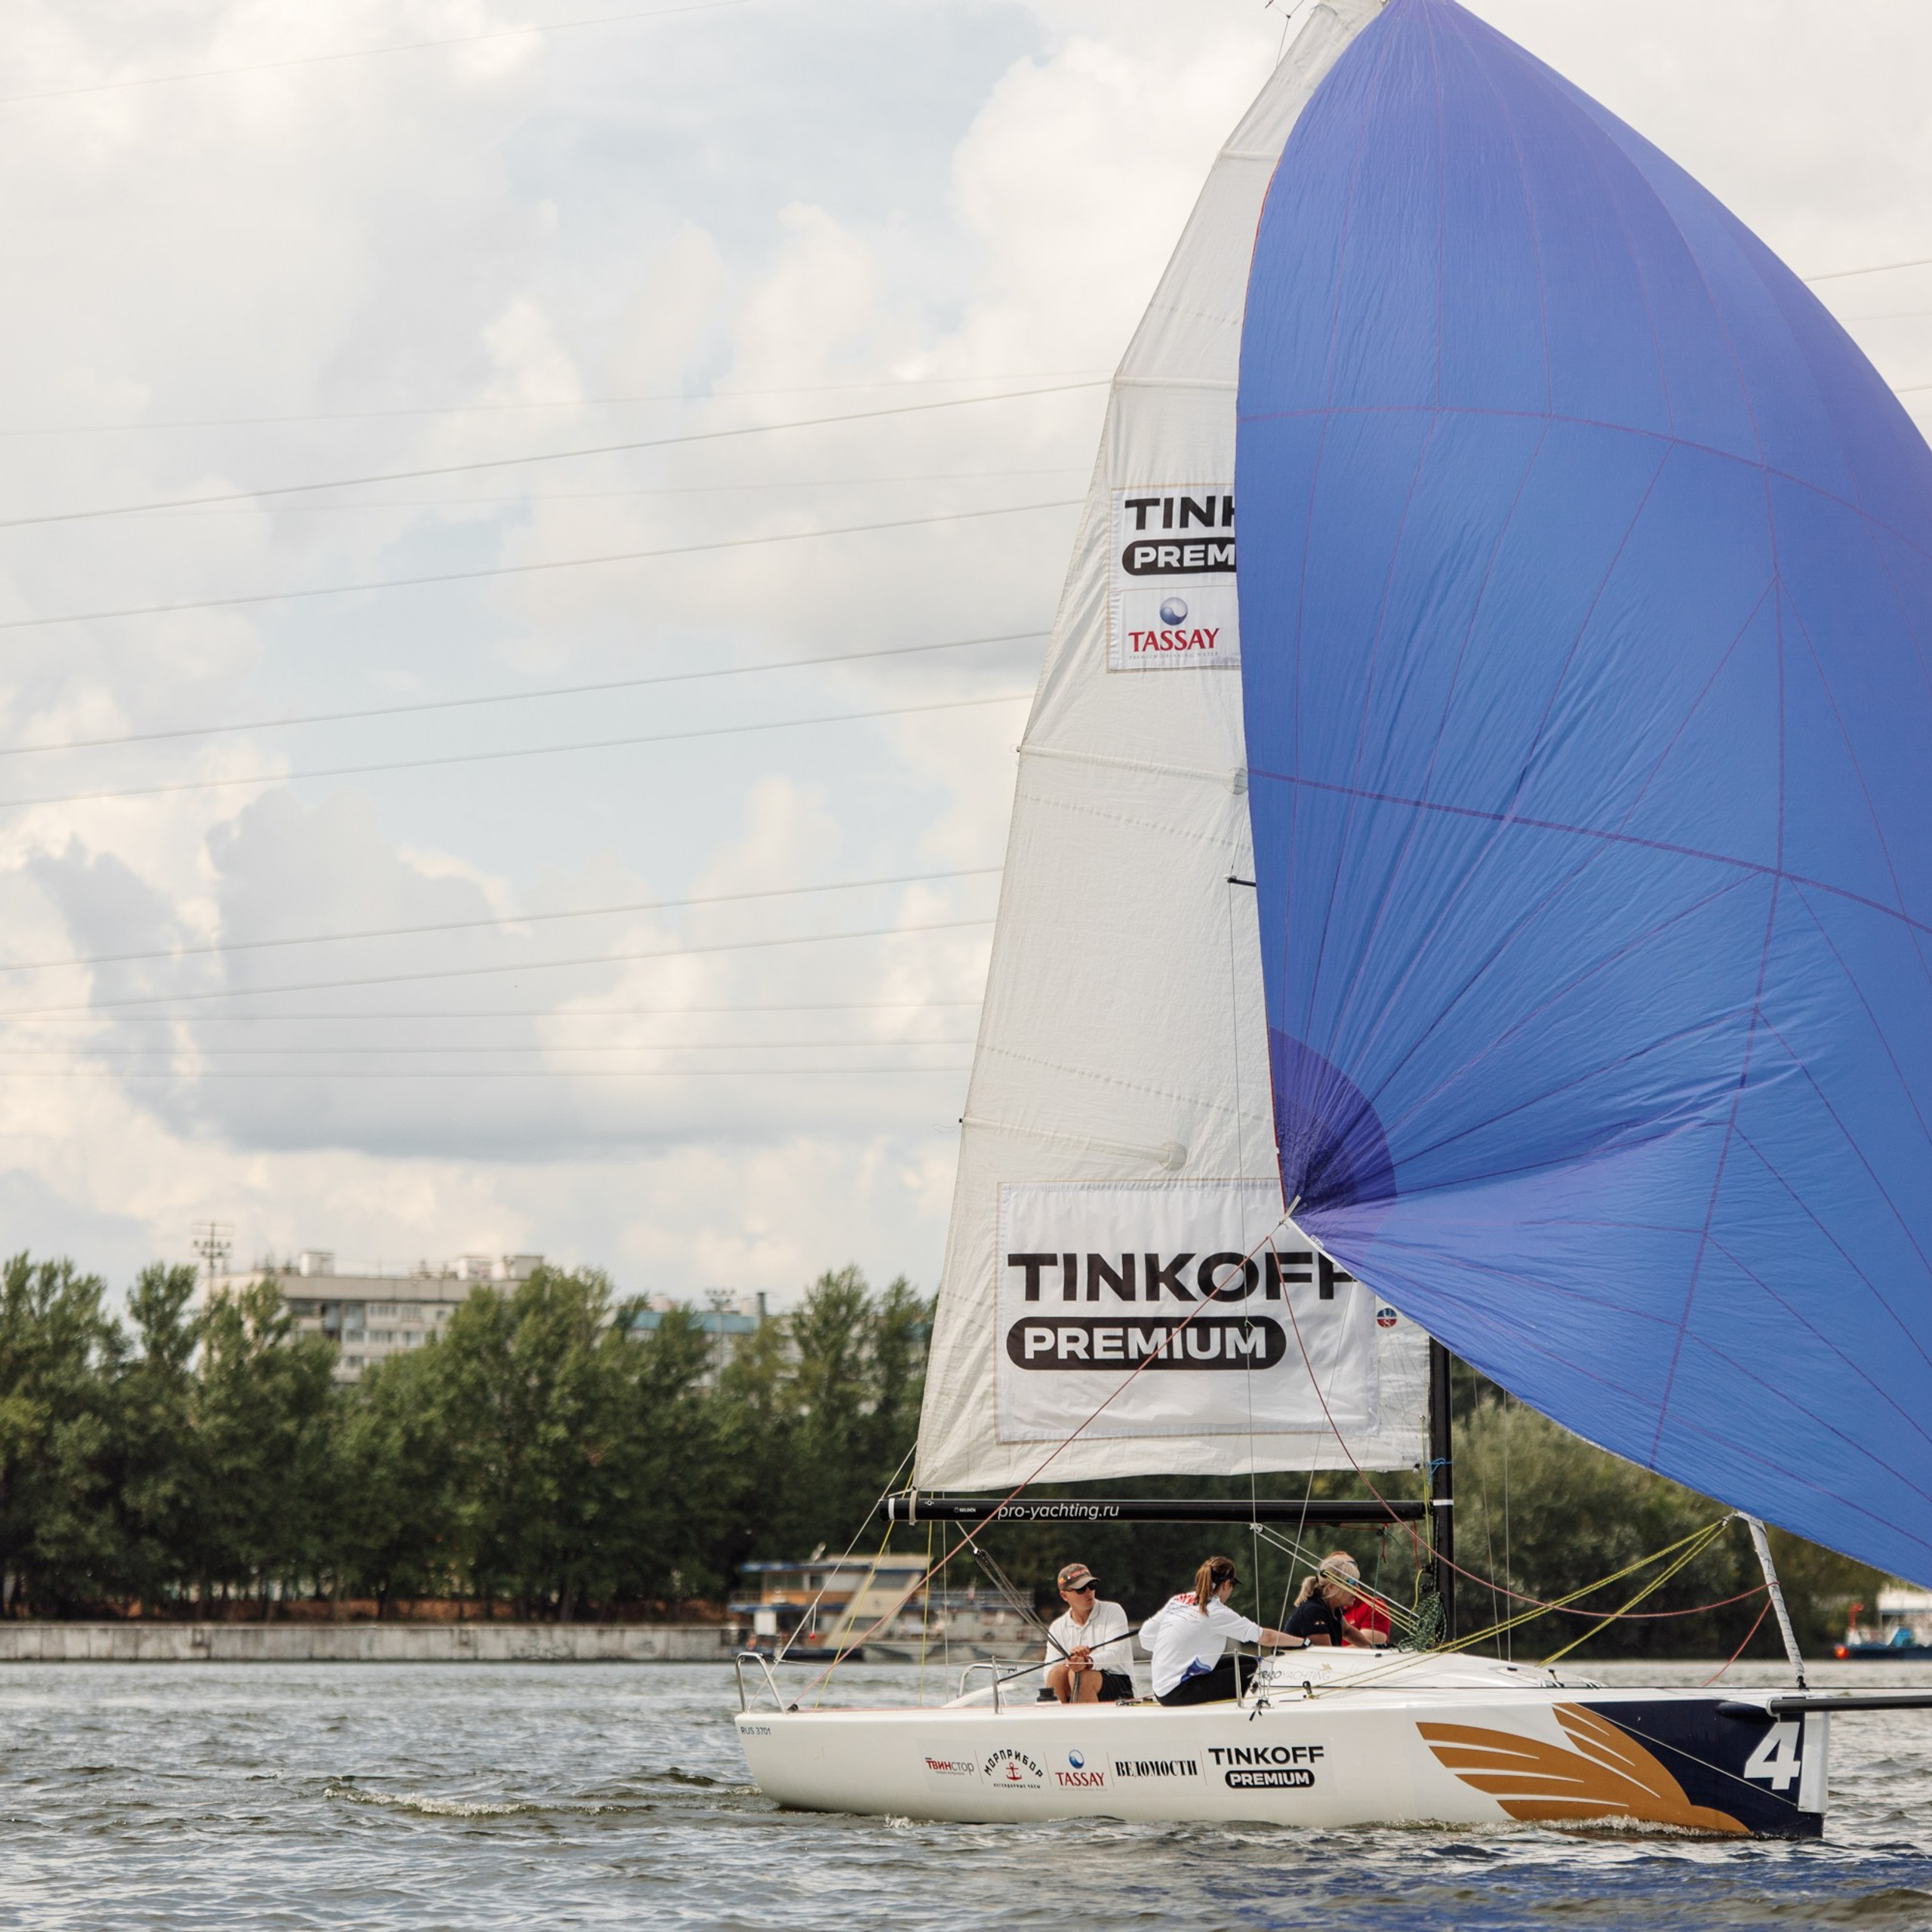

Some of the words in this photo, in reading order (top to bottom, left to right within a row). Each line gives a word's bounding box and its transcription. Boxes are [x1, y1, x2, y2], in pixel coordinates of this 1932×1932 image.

[1134, 543, 1235, 569] PREM
[1128, 628, 1220, 652] TASSAY
[1024, 1327, 1266, 1359] PREMIUM
[998, 1503, 1119, 1520] pro-yachting.ru
[740, 1726, 755, 1735] RUS
[755, 1727, 771, 1735] 3701
[983, 1749, 1043, 1777] МОРПРИБОР
[1208, 1746, 1324, 1766] TINKOFF
[1743, 1721, 1801, 1790] 4
[1054, 1771, 1104, 1786] TASSAY
[1115, 1759, 1198, 1778] ВЕДОМОСТИ
[1229, 1772, 1310, 1786] PREMIUM
